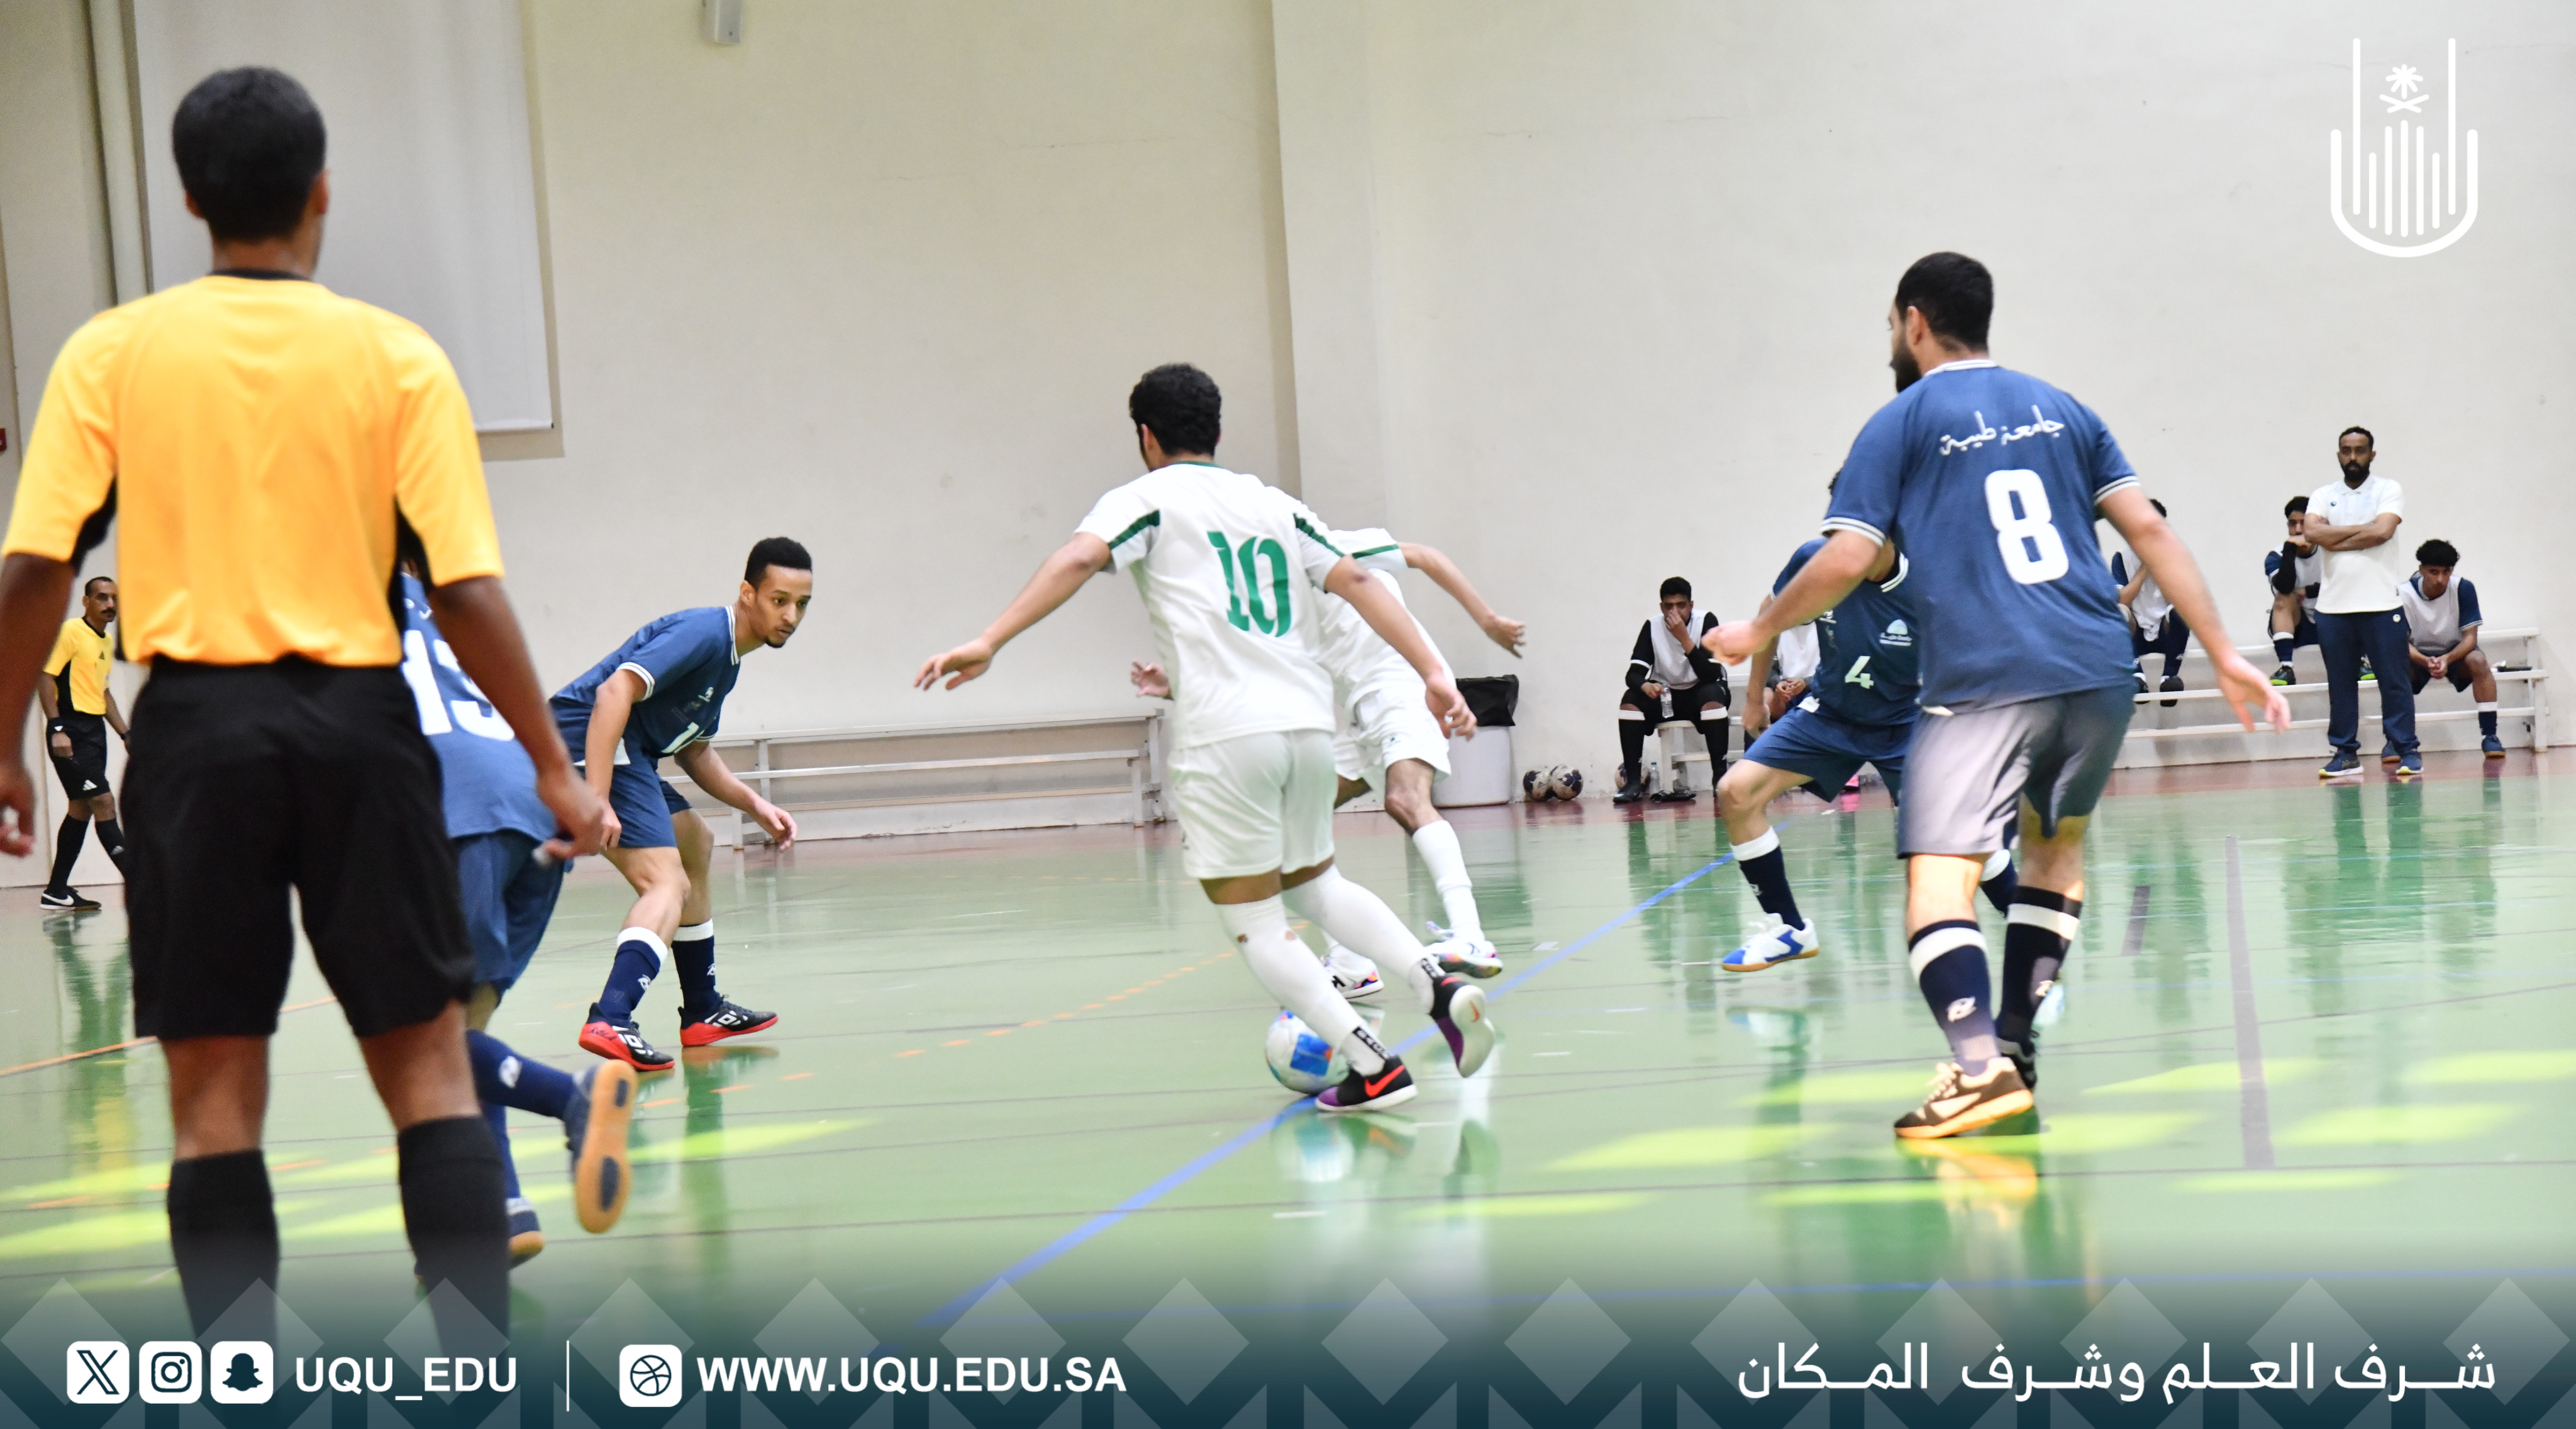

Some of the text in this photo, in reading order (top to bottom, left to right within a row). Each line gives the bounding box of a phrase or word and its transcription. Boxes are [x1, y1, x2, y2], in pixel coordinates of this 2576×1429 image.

[1940, 404, 2065, 456] جامعة طيبة
[1985, 469, 2070, 586] 8
[1207, 531, 1292, 637] 10
[1844, 655, 1875, 690] 4
